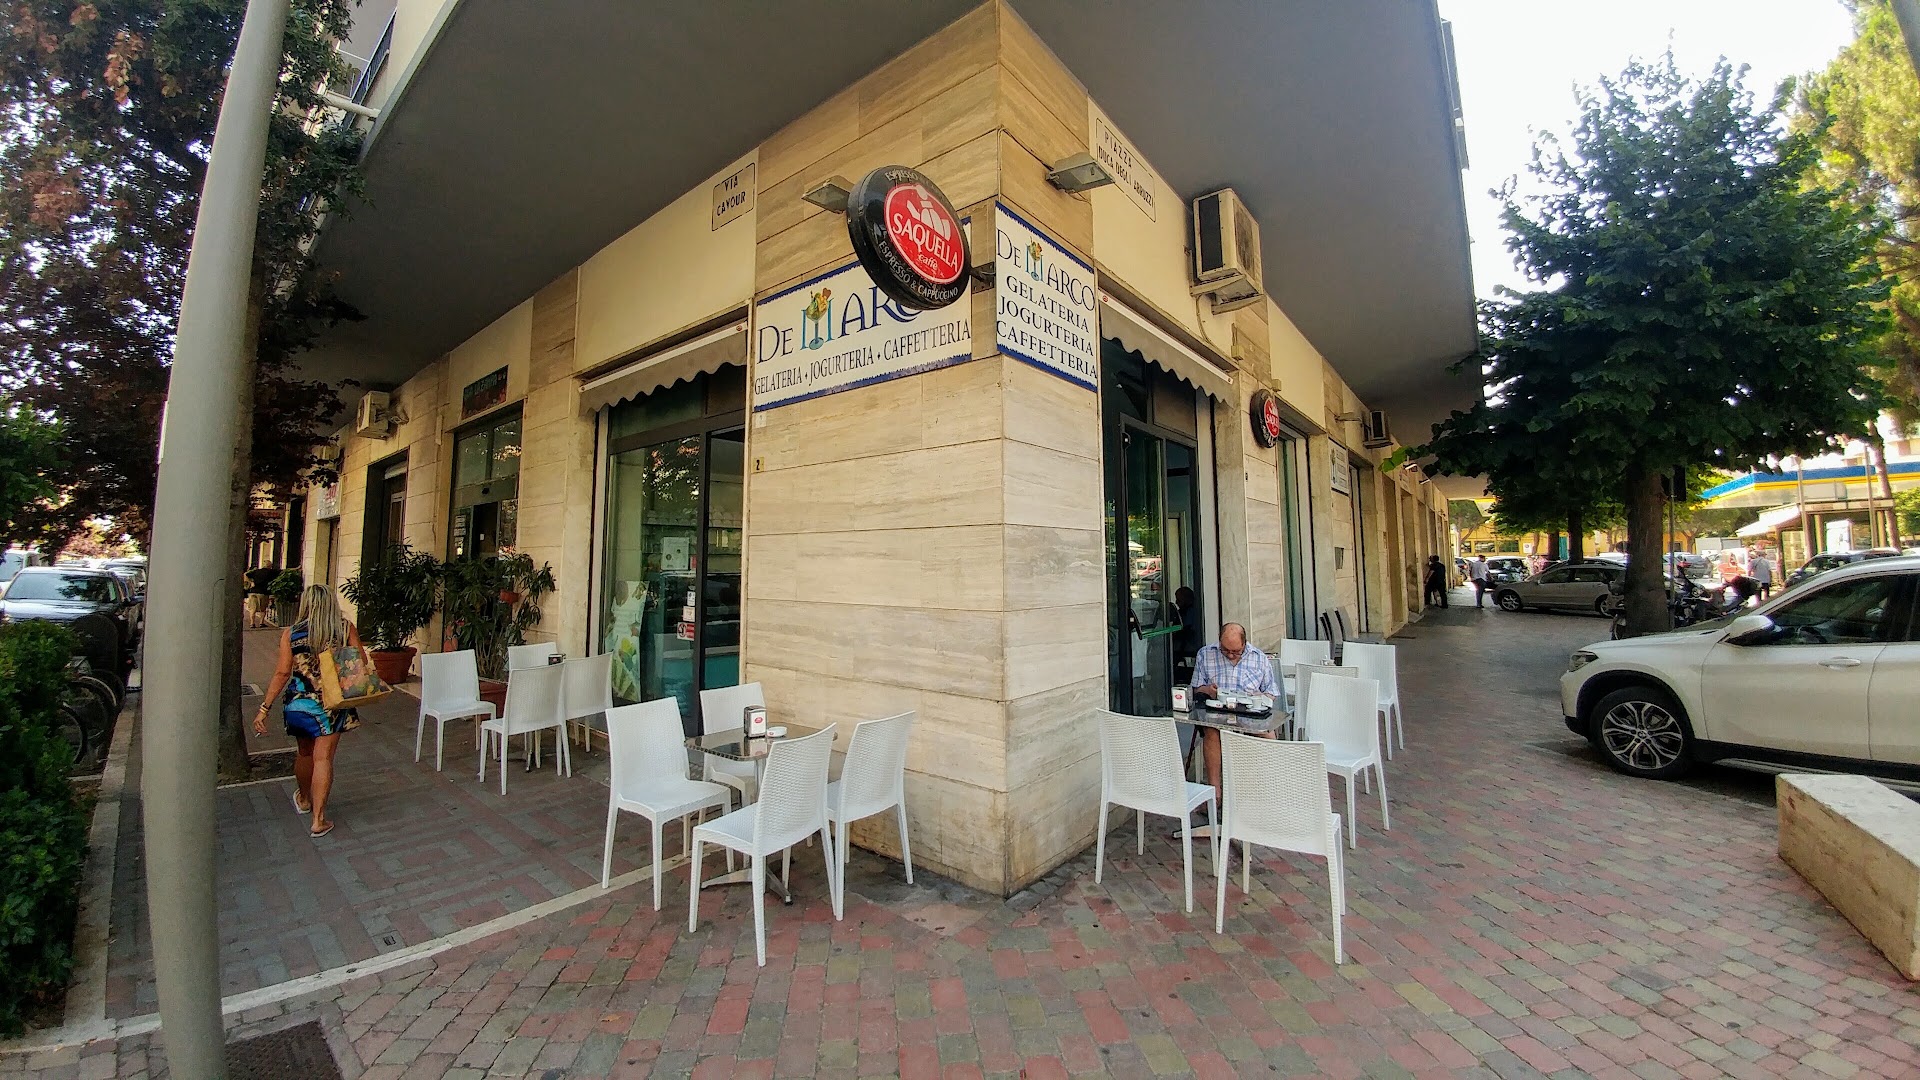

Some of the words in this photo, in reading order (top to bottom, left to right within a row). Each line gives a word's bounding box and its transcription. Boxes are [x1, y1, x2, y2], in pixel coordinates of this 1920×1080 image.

[1098, 145, 1114, 169] DUCA
[1115, 161, 1132, 185] DEGLI
[1104, 131, 1132, 168] PIAZZA
[716, 191, 746, 216] CAVOUR
[724, 175, 739, 191] VIA
[878, 240, 911, 283] ESPRESSO
[917, 284, 959, 300] CAPPUCCINO
[892, 212, 959, 273] SAQUELLA
[998, 295, 1094, 357] JOGURTERIA
[1006, 275, 1090, 333] GELATERIA
[754, 366, 803, 395] GELATERIA
[807, 346, 875, 386] JOGURTERIA
[883, 317, 971, 361] CAFFETTERIA
[996, 320, 1098, 379] CAFFETTERIA
